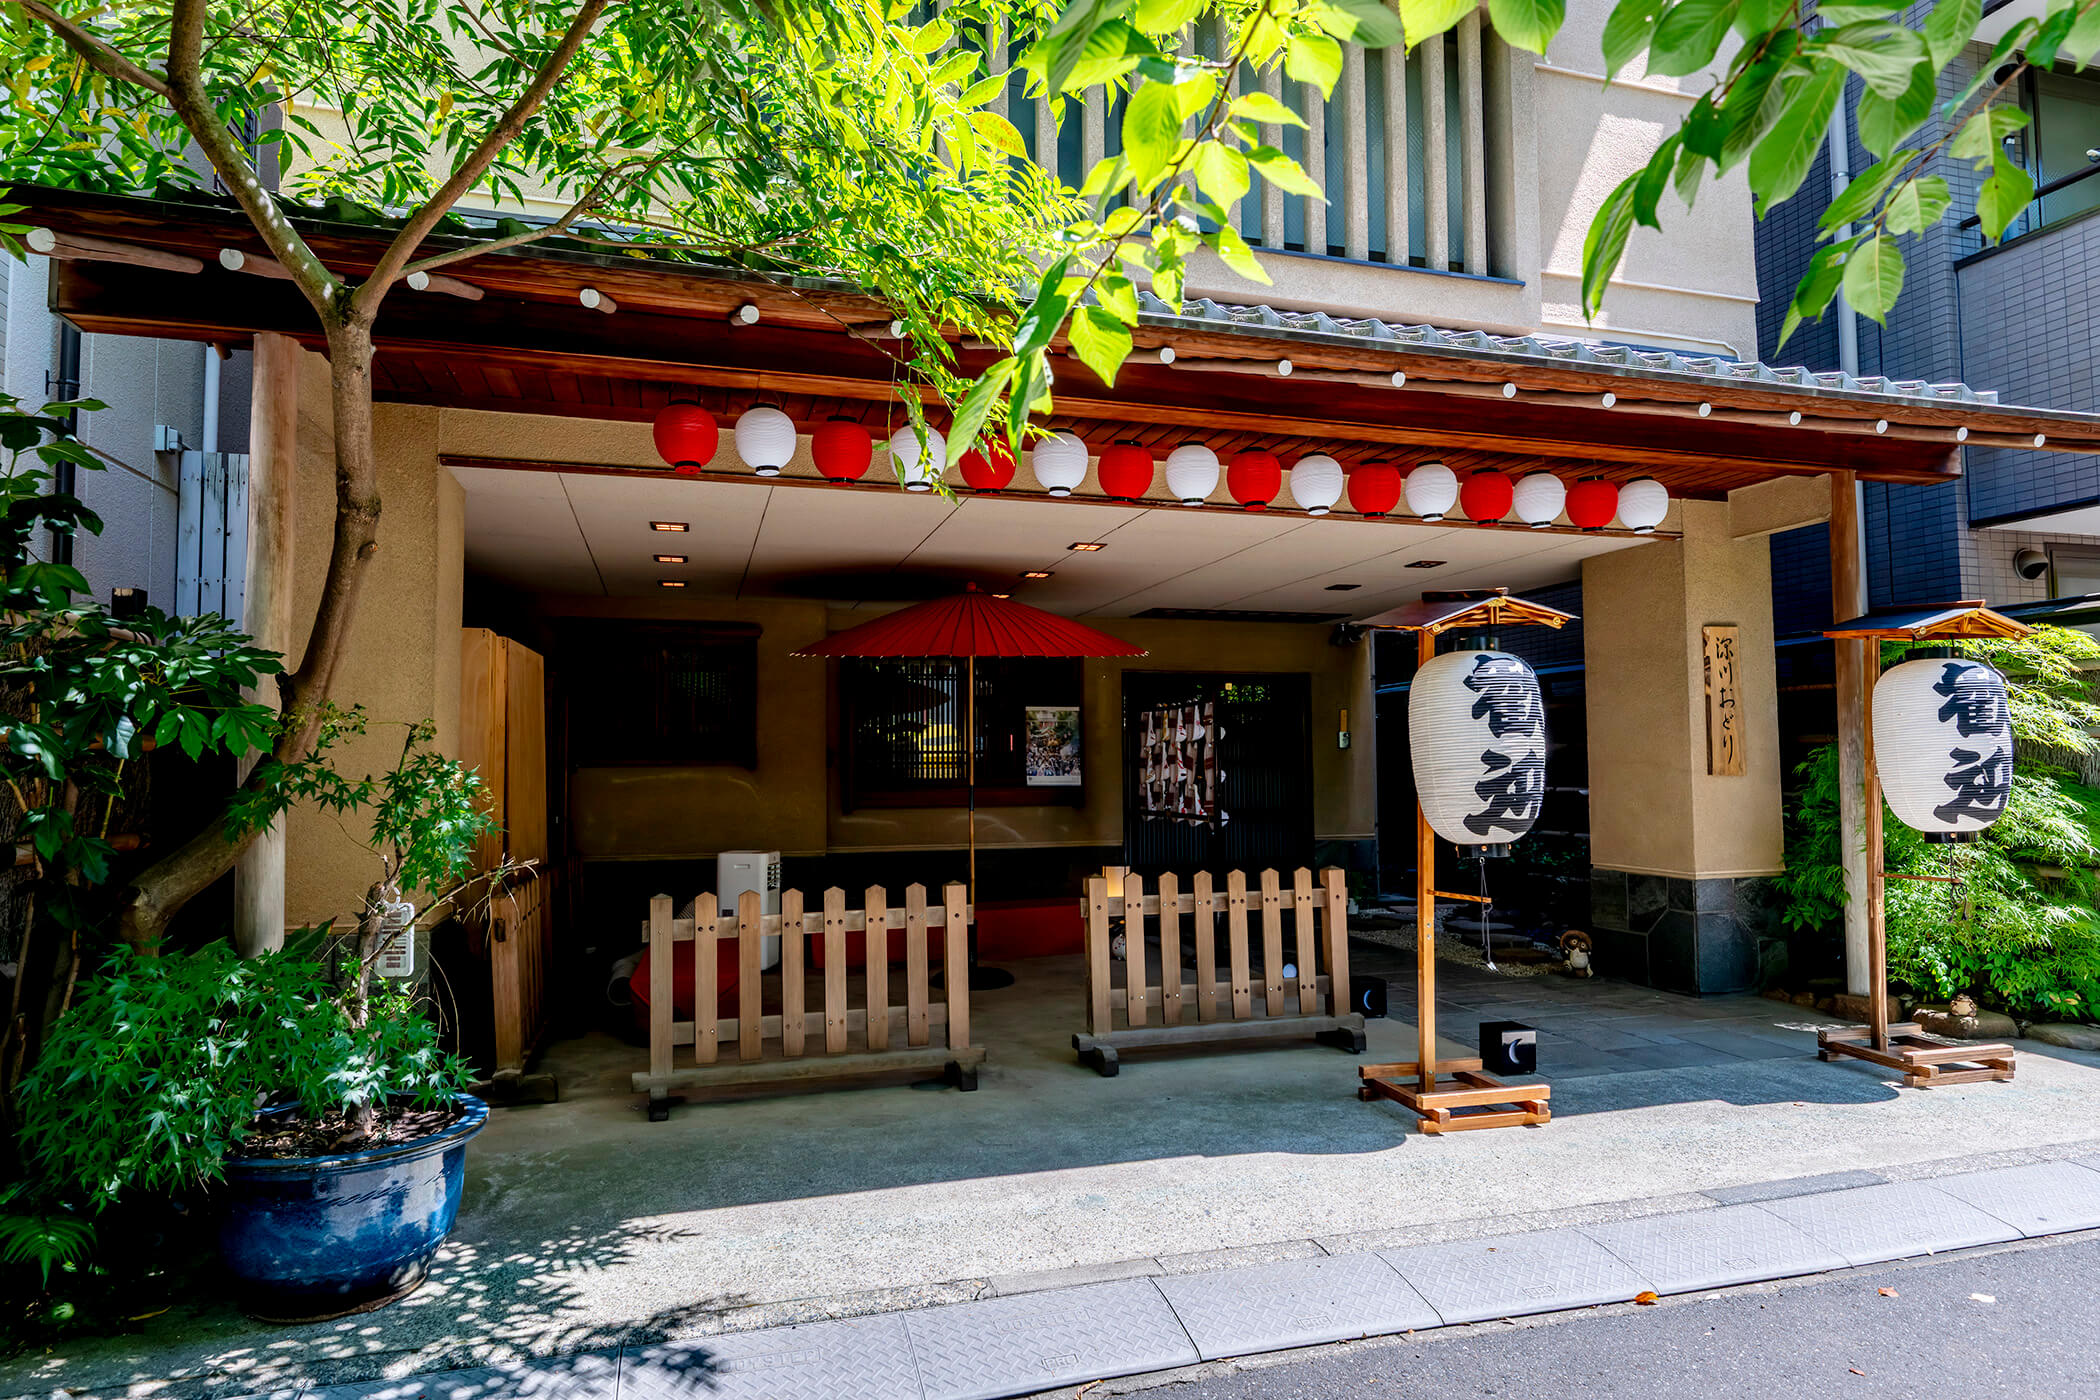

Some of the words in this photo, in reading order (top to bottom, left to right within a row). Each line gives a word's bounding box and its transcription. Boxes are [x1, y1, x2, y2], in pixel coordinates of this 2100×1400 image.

[1715, 637, 1736, 764] 深川おどり
